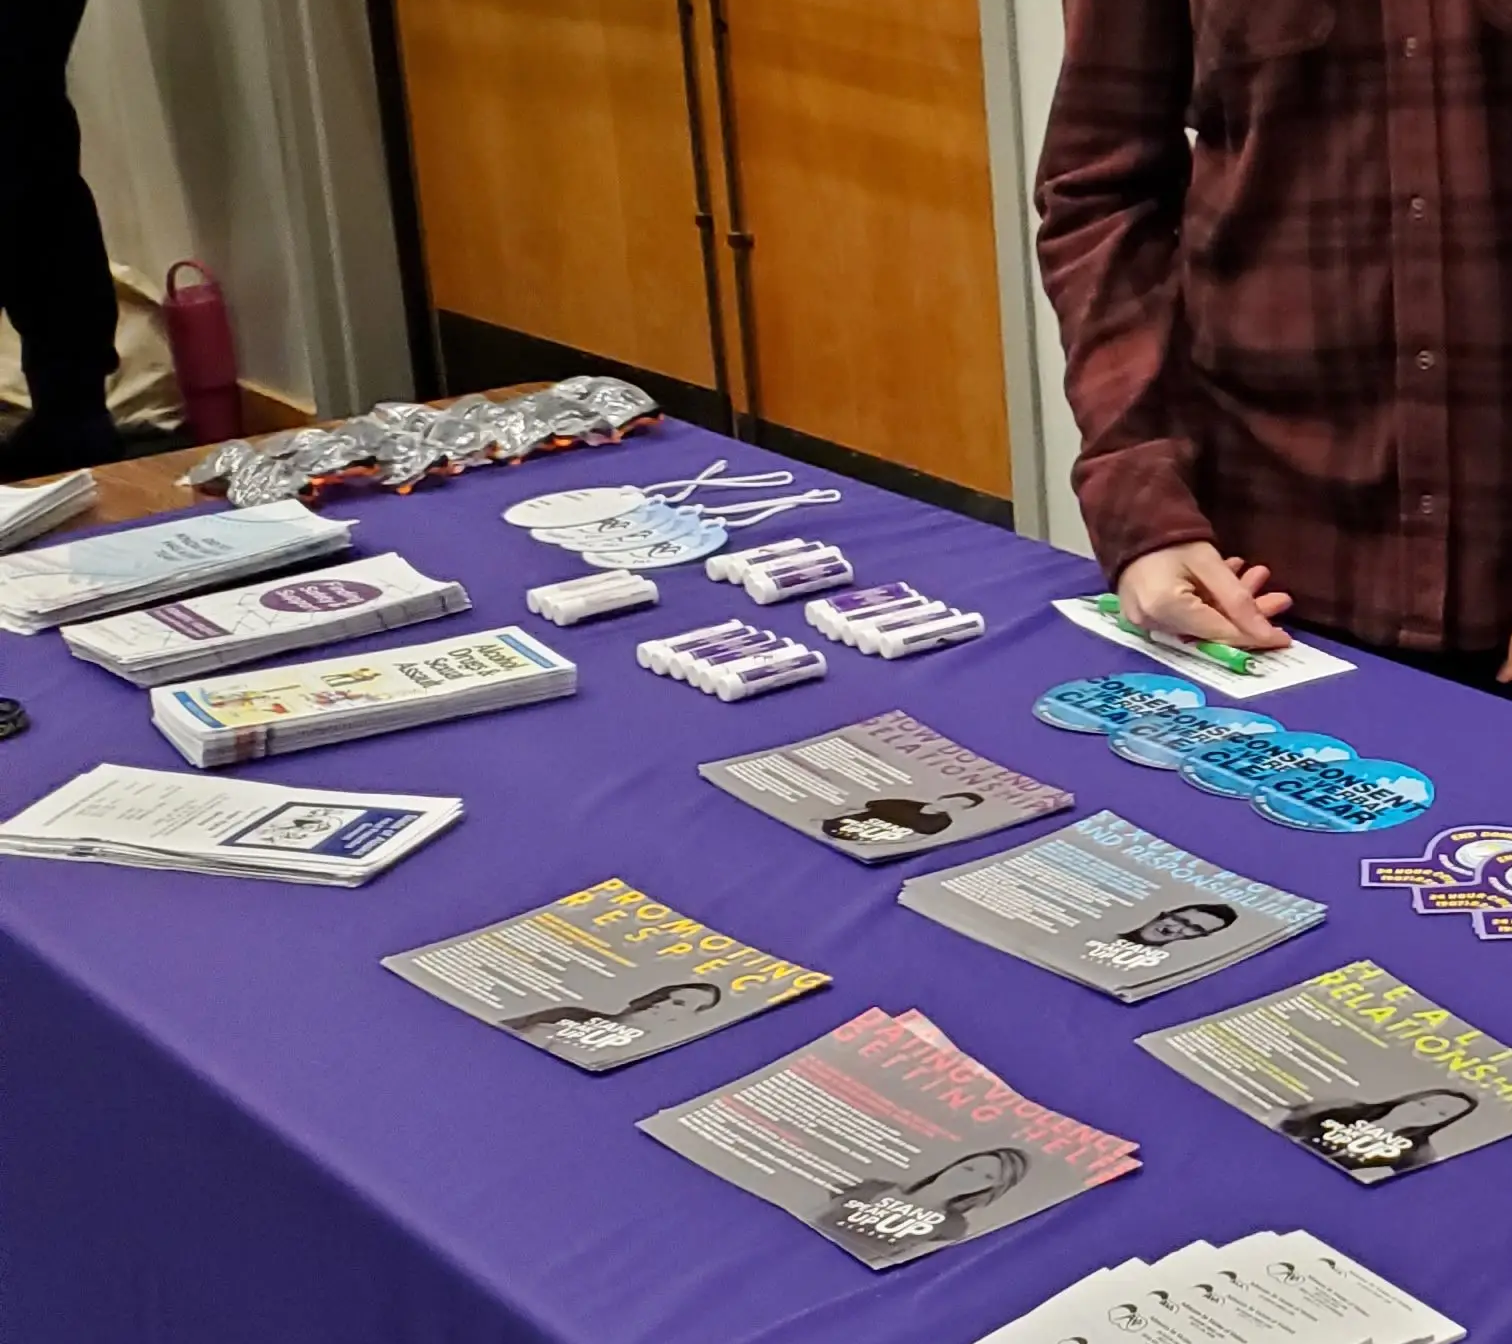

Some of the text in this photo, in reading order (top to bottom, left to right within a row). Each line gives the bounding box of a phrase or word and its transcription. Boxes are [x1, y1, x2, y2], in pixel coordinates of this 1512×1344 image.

[393, 661, 445, 689] Assault
[424, 656, 475, 681] Sexual
[1303, 760, 1430, 814] CONSENT
[1314, 778, 1387, 818] VERBAL
[1272, 780, 1378, 826] CLEAR
[558, 889, 801, 1004] RESPECT
[591, 877, 834, 991] PROMOTING
[1111, 951, 1161, 969] UP
[580, 1030, 632, 1048] UP
[831, 1023, 1004, 1124] GETTING
[1009, 1125, 1118, 1172] HELP
[982, 1074, 1134, 1156] VIOLENCE
[1347, 1136, 1401, 1159] UP
[1349, 1119, 1414, 1149] STAND
[874, 1197, 946, 1225] STAND
[875, 1213, 934, 1238] UP
